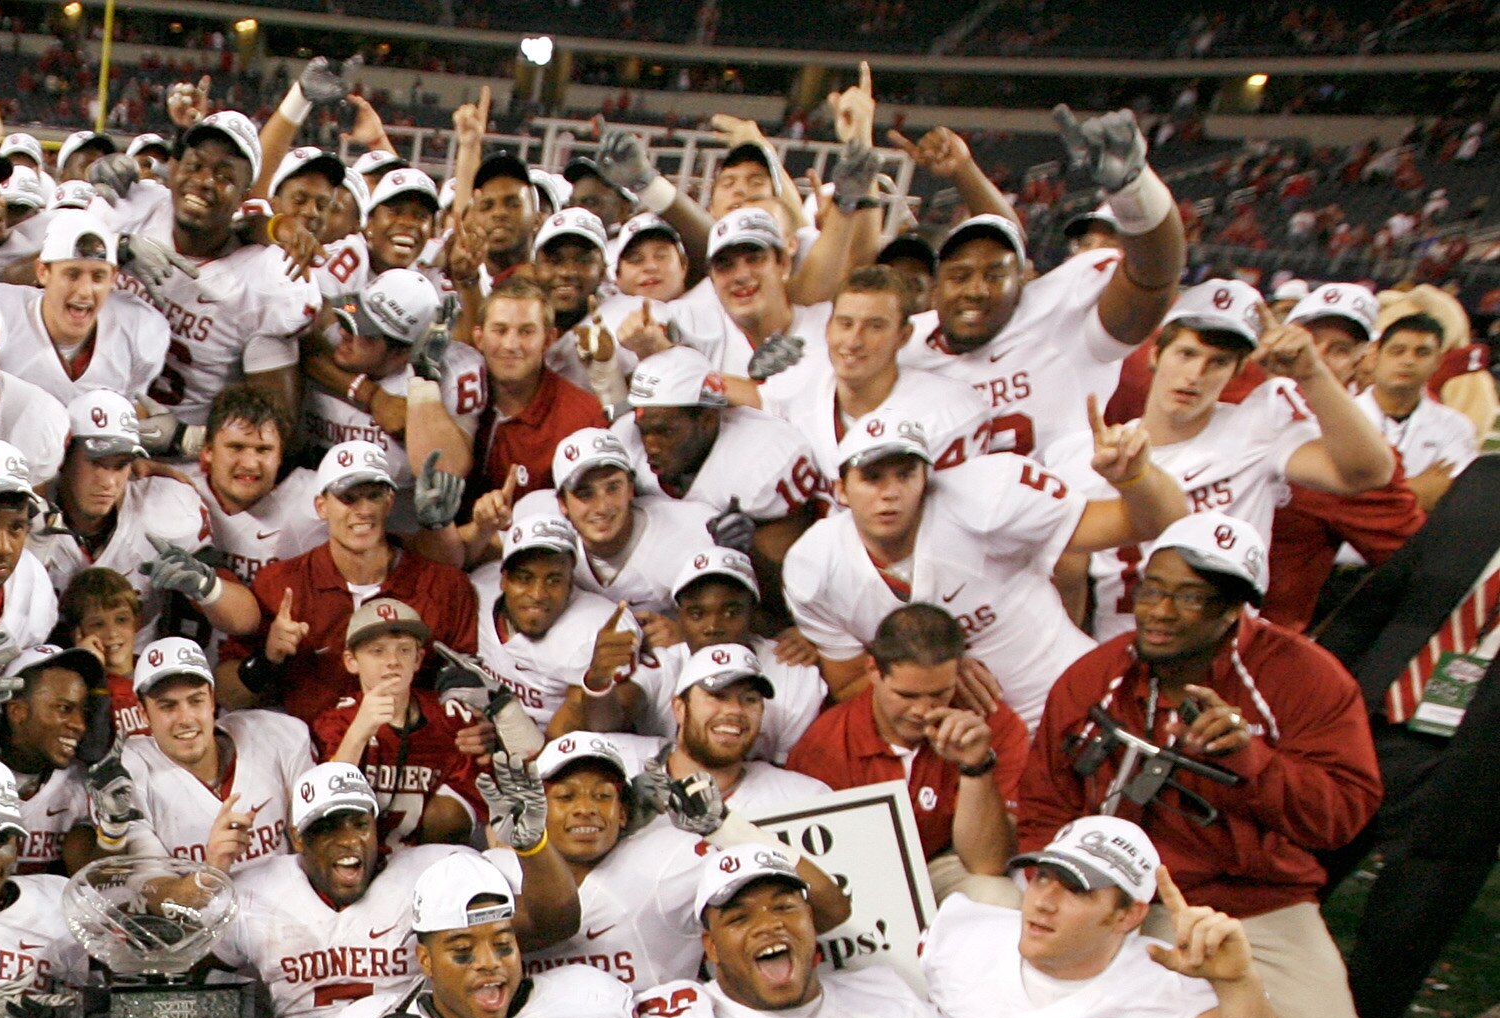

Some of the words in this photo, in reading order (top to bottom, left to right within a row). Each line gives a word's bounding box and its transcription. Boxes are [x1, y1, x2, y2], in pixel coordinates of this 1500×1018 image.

[1214, 289, 1232, 309] OU
[91, 407, 108, 428] OU
[866, 419, 885, 437] OU
[338, 450, 353, 466] OU
[566, 445, 579, 461] OU
[776, 456, 818, 516] 16
[1020, 464, 1068, 500] 5
[1214, 525, 1235, 549] OU
[695, 554, 709, 569] OU
[378, 604, 398, 622] OU
[148, 649, 164, 666] OU
[712, 650, 731, 664] OU
[559, 739, 576, 755] OU
[301, 782, 315, 803] OU
[1112, 837, 1137, 857] BIG
[720, 856, 741, 874] OU
[280, 947, 408, 983] SOONERS
